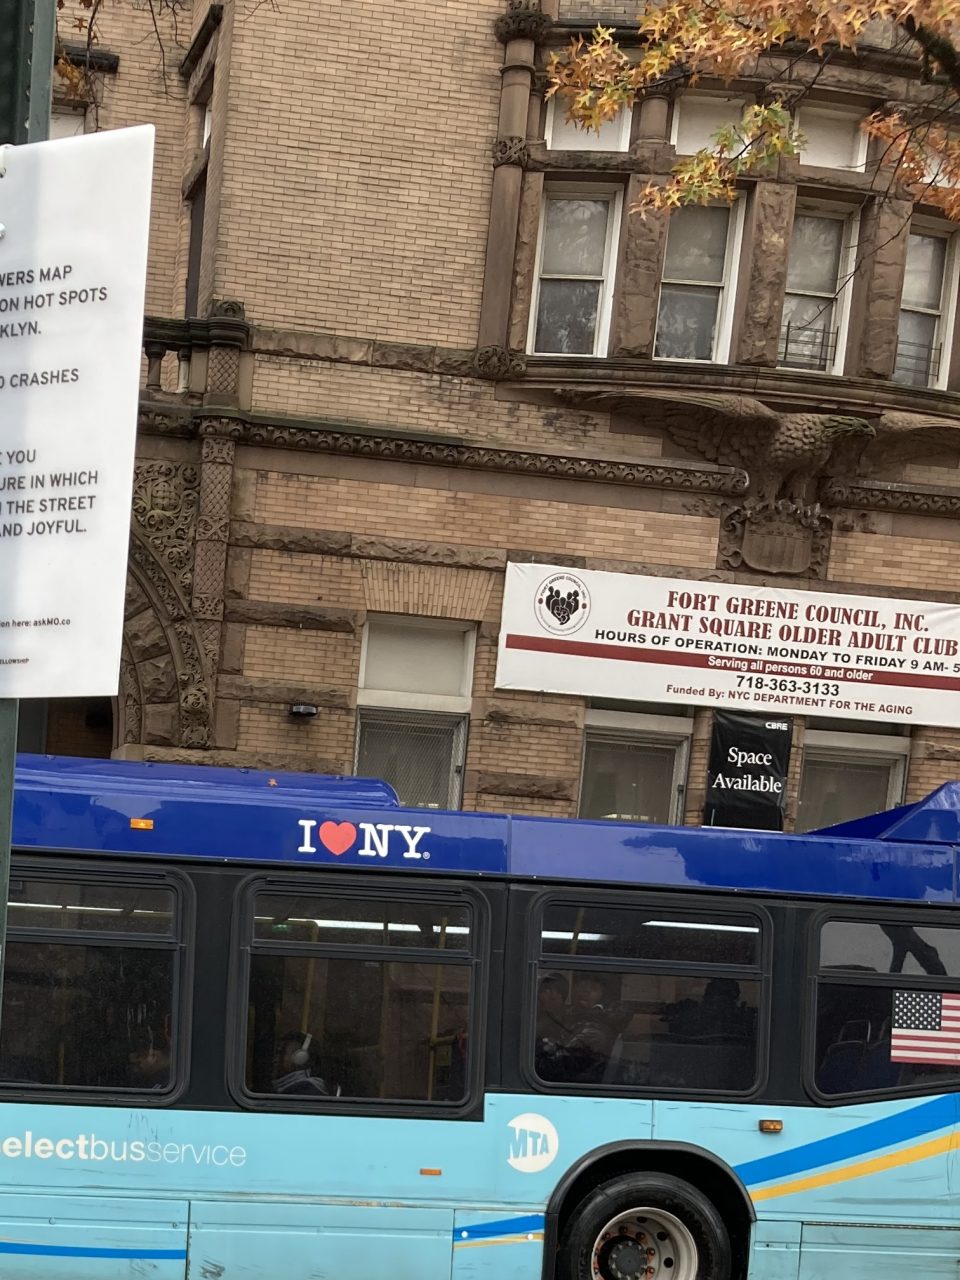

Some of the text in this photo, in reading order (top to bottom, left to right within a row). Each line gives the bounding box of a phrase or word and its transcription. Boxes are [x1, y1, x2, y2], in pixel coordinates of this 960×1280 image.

[40, 265, 73, 281] MAP
[24, 293, 54, 309] HOT
[58, 287, 108, 306] SPOTS
[10, 368, 80, 388] CRASHES
[6, 449, 37, 465] YOU
[31, 475, 45, 488] IN
[49, 471, 99, 487] WHICH
[6, 500, 35, 515] THE
[39, 496, 97, 512] STREET
[27, 519, 87, 536] JOYFUL.
[667, 590, 929, 632] FORT GREENE COUNCIL, INC.
[11, 619, 32, 629] here:
[33, 618, 71, 628] askMO.co
[627, 609, 959, 656] GRANT SQUARE OLDER ADULT CLUB
[595, 629, 646, 644] HOURS
[651, 635, 670, 646] OF
[675, 637, 763, 656] OPERATION:
[767, 646, 828, 661] MONDAY
[832, 652, 851, 663] TO
[855, 655, 907, 669] FRIDAY
[910, 659, 919, 669] 9
[708, 656, 874, 681] Serving all persons 60 and older
[736, 675, 840, 696] 718-363-3133
[666, 684, 913, 715] Funded By: NYC DEPARTMENT FOR THE AGING
[765, 721, 788, 731] CBRE
[727, 746, 773, 767] Space
[712, 773, 782, 793] Available
[298, 819, 317, 853] I
[507, 1127, 550, 1161] MTA
